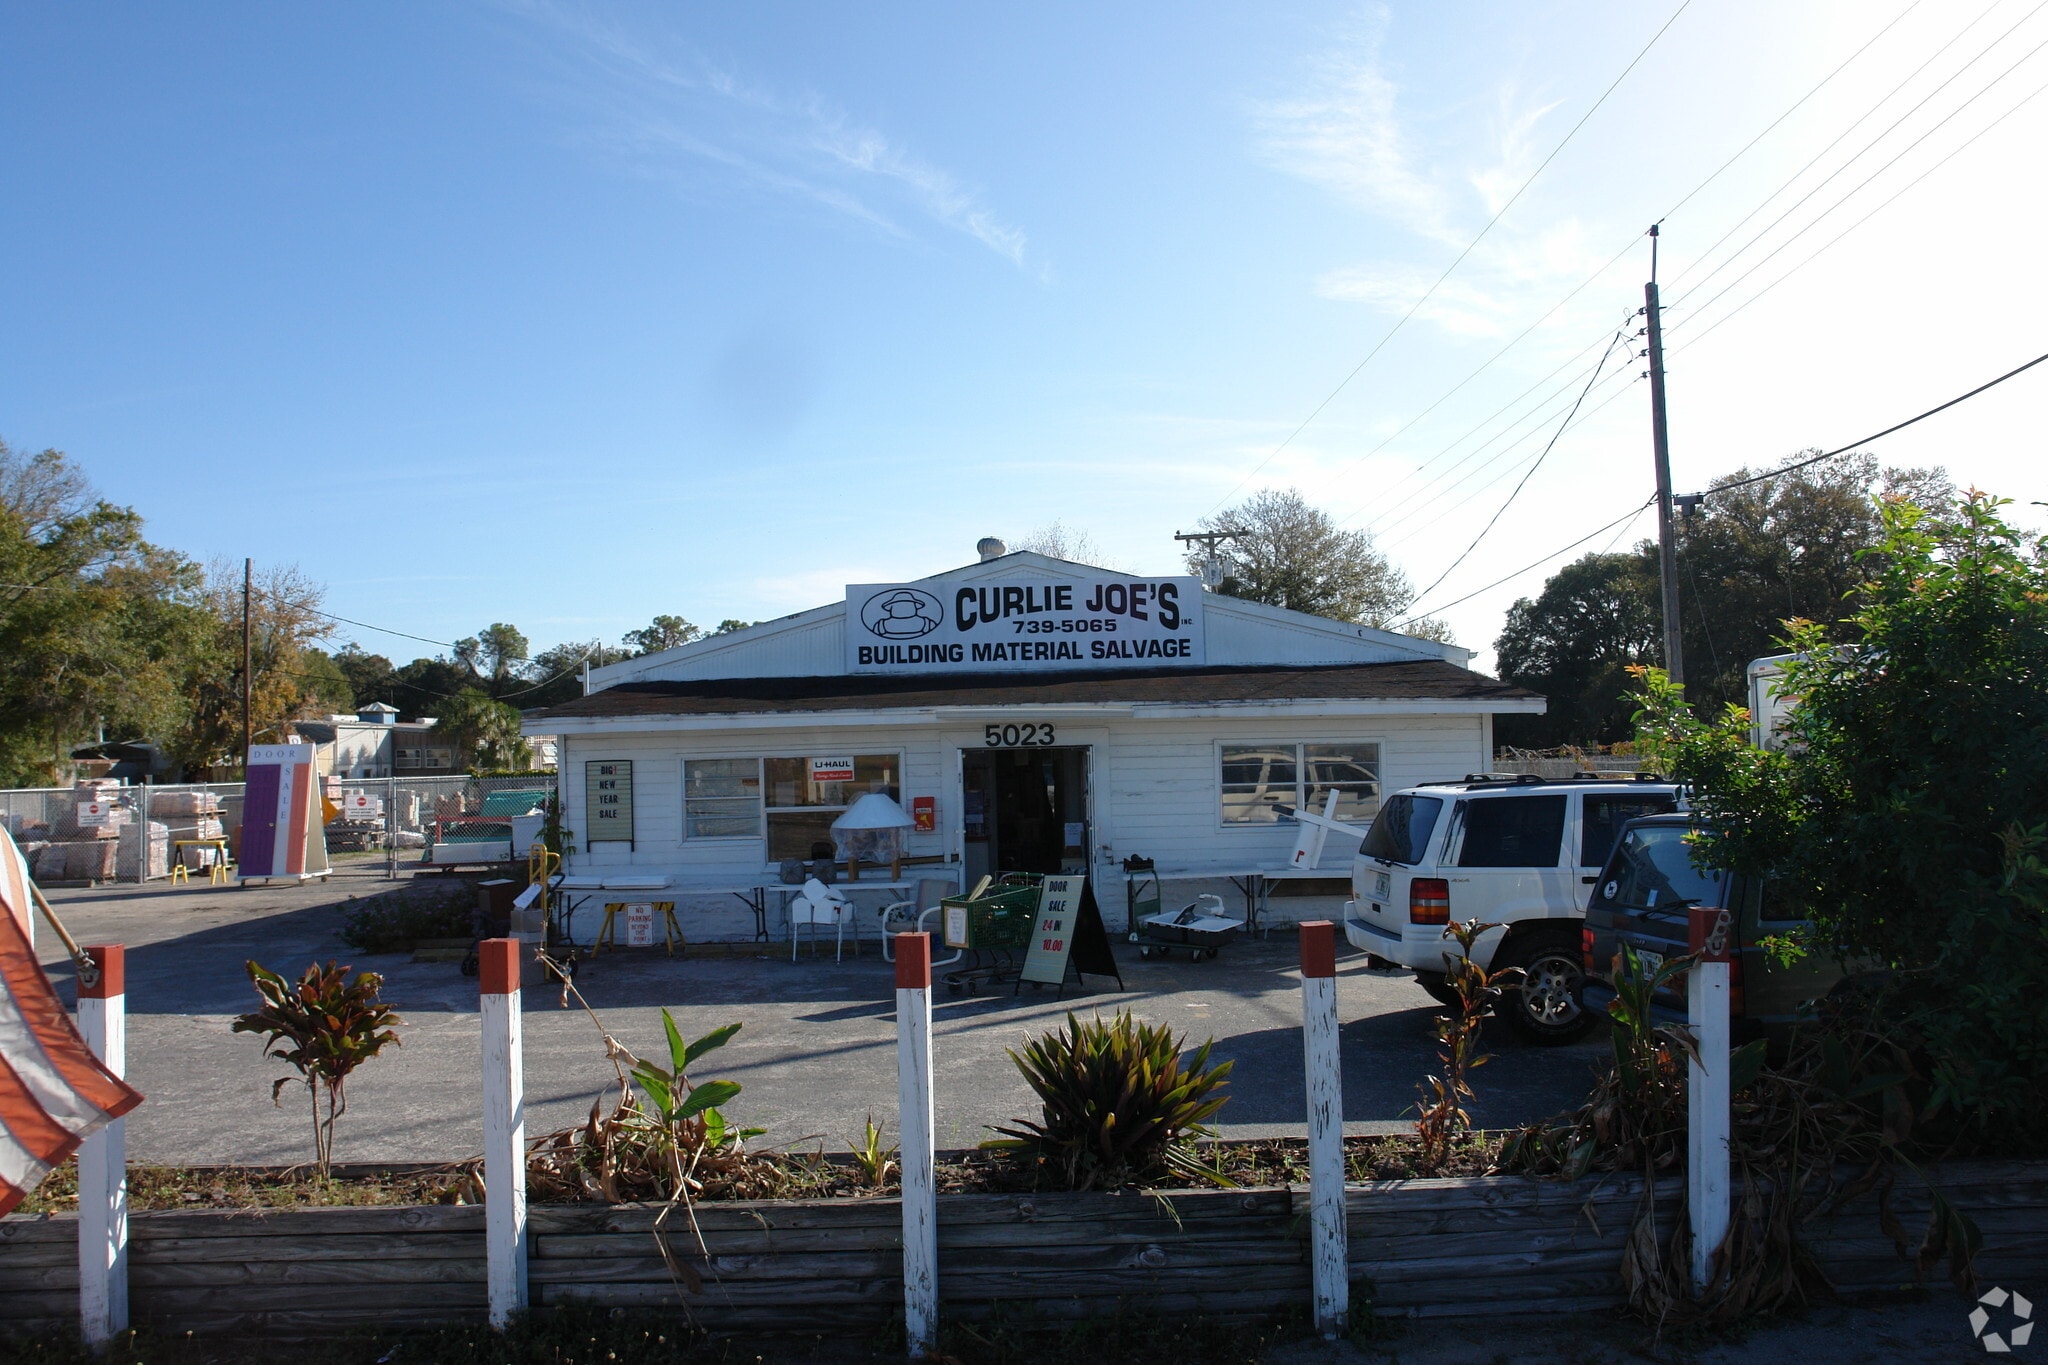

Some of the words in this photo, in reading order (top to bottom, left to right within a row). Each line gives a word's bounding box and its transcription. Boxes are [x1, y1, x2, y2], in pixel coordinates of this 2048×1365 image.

[955, 585, 1073, 632] CURLIE
[1085, 583, 1180, 631] JOE'S
[1012, 619, 1117, 634] 739-5065
[858, 643, 964, 665] BUILDING
[971, 641, 1084, 662] MATERIAL
[1091, 638, 1191, 660] SALVAGE
[985, 723, 1056, 747] 5023
[254, 750, 296, 759] DOOR
[599, 780, 615, 789] NEW
[281, 767, 291, 819] SALE
[599, 795, 618, 804] YEAR
[599, 809, 617, 818] SALE
[1049, 880, 1068, 892] DOOR
[635, 906, 644, 914] NO
[1048, 900, 1067, 912] SALE
[1042, 919, 1053, 931] 24
[1043, 939, 1063, 952] 10.00
